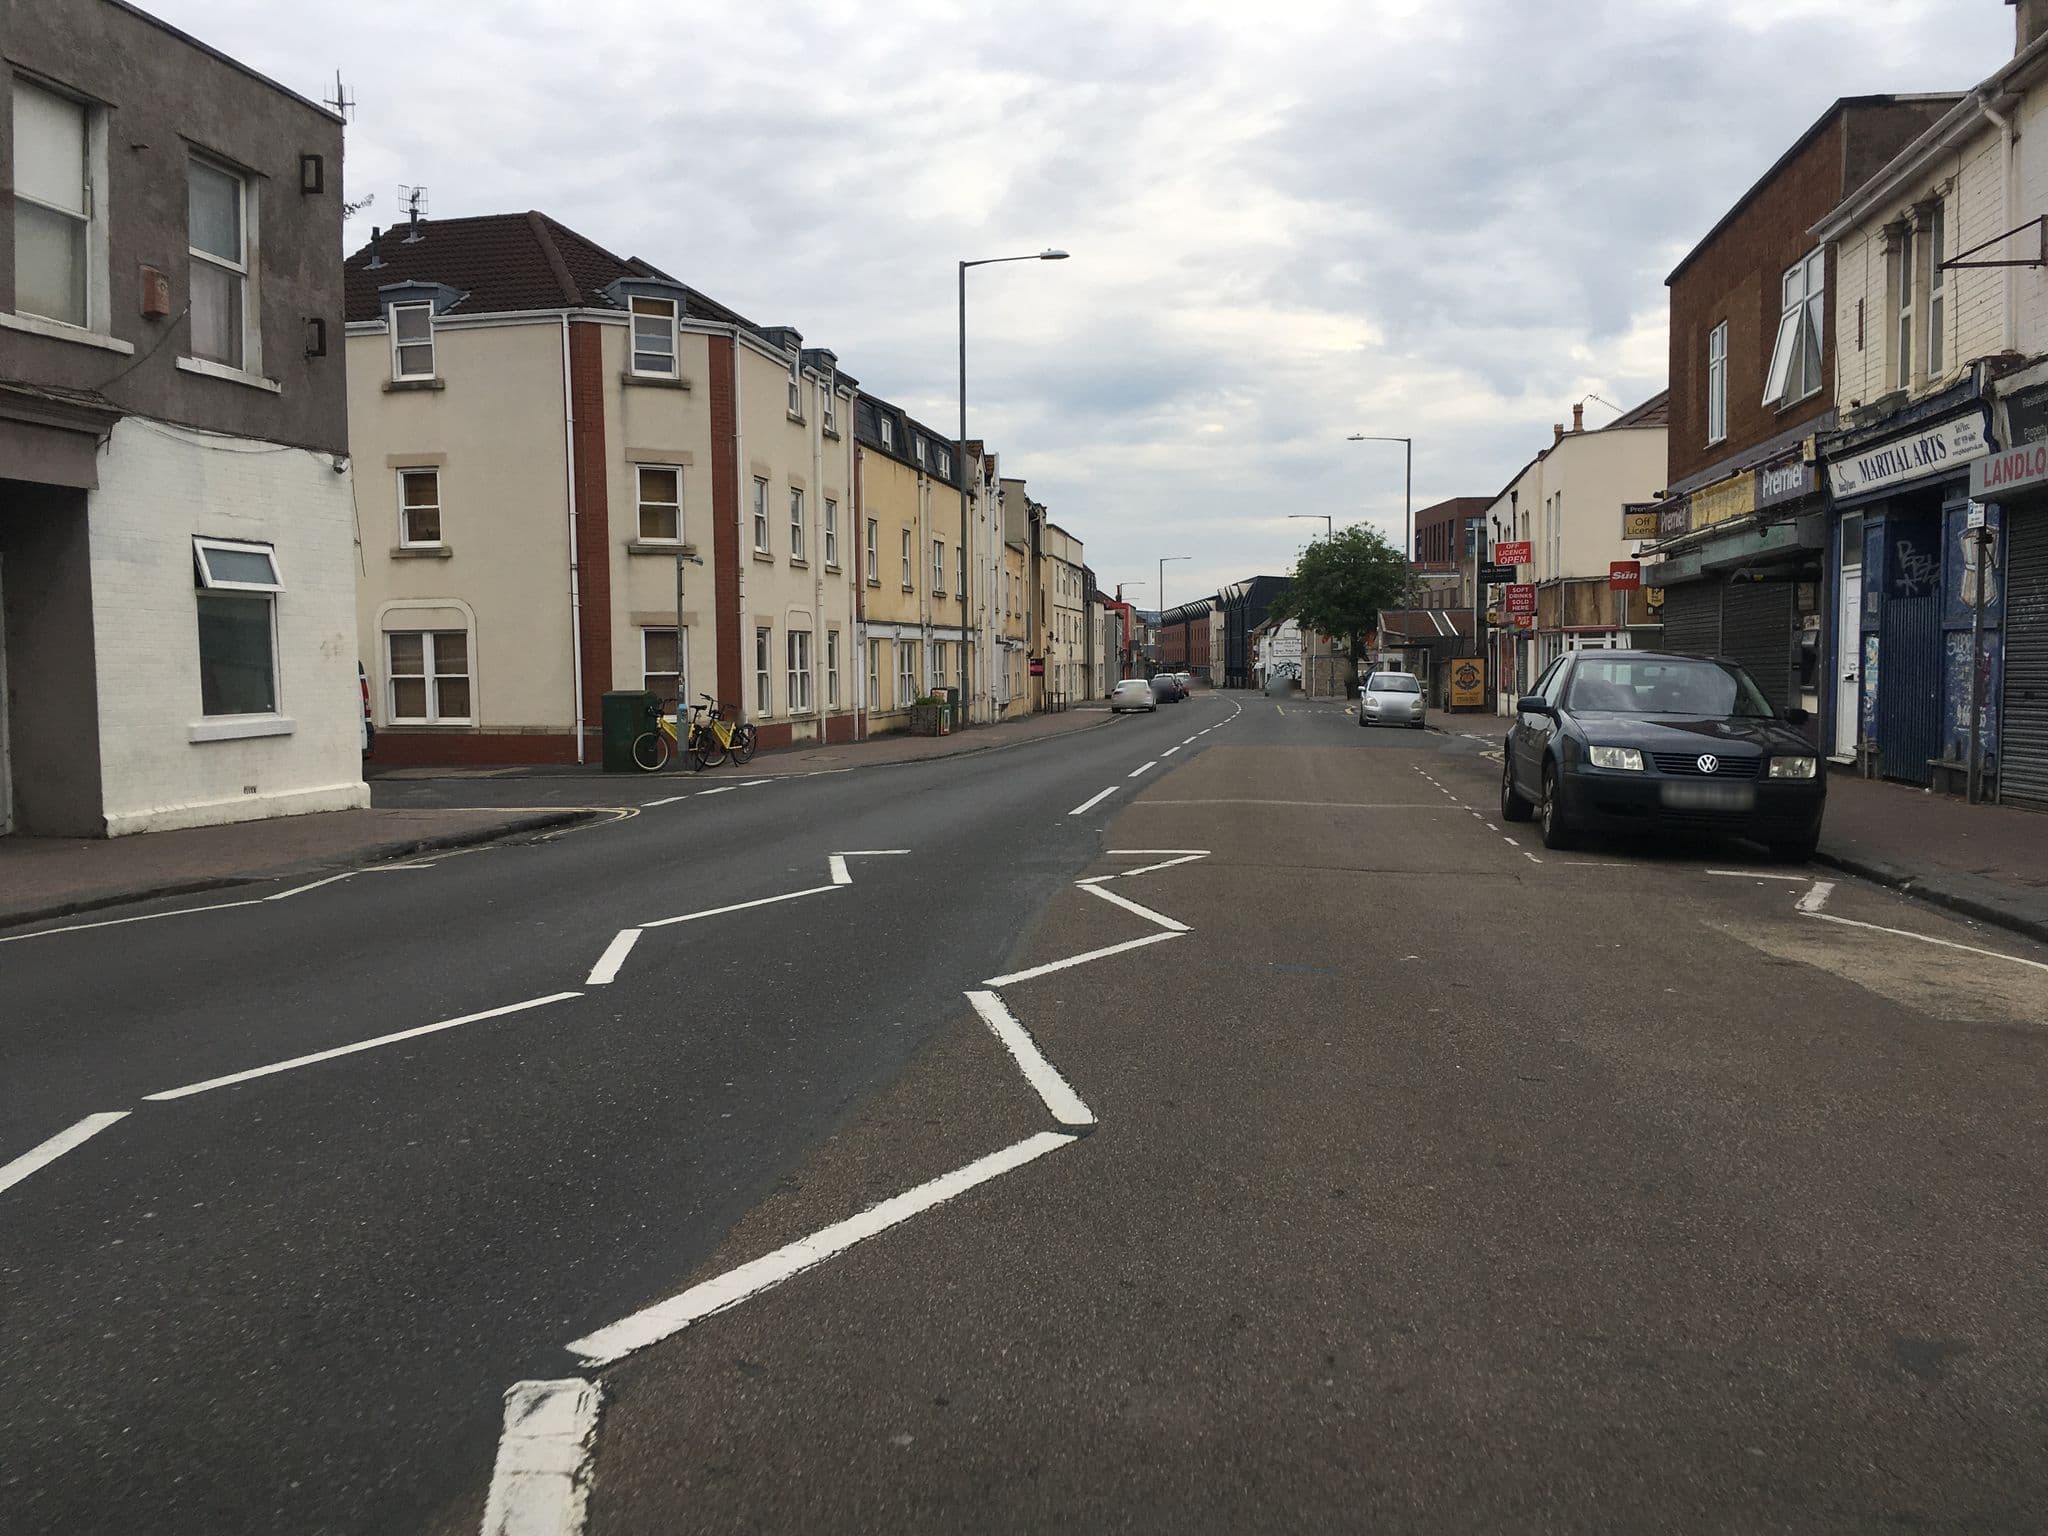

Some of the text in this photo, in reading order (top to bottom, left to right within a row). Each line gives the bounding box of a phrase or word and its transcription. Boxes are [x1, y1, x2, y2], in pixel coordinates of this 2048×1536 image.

[1858, 433, 1947, 483] MARTIAL ARTS
[1762, 462, 1804, 499] Premier
[1635, 517, 1650, 526] Off
[1499, 549, 1528, 557] LICENCE
[1500, 555, 1527, 565] OPEN
[1612, 571, 1638, 580] Sun
